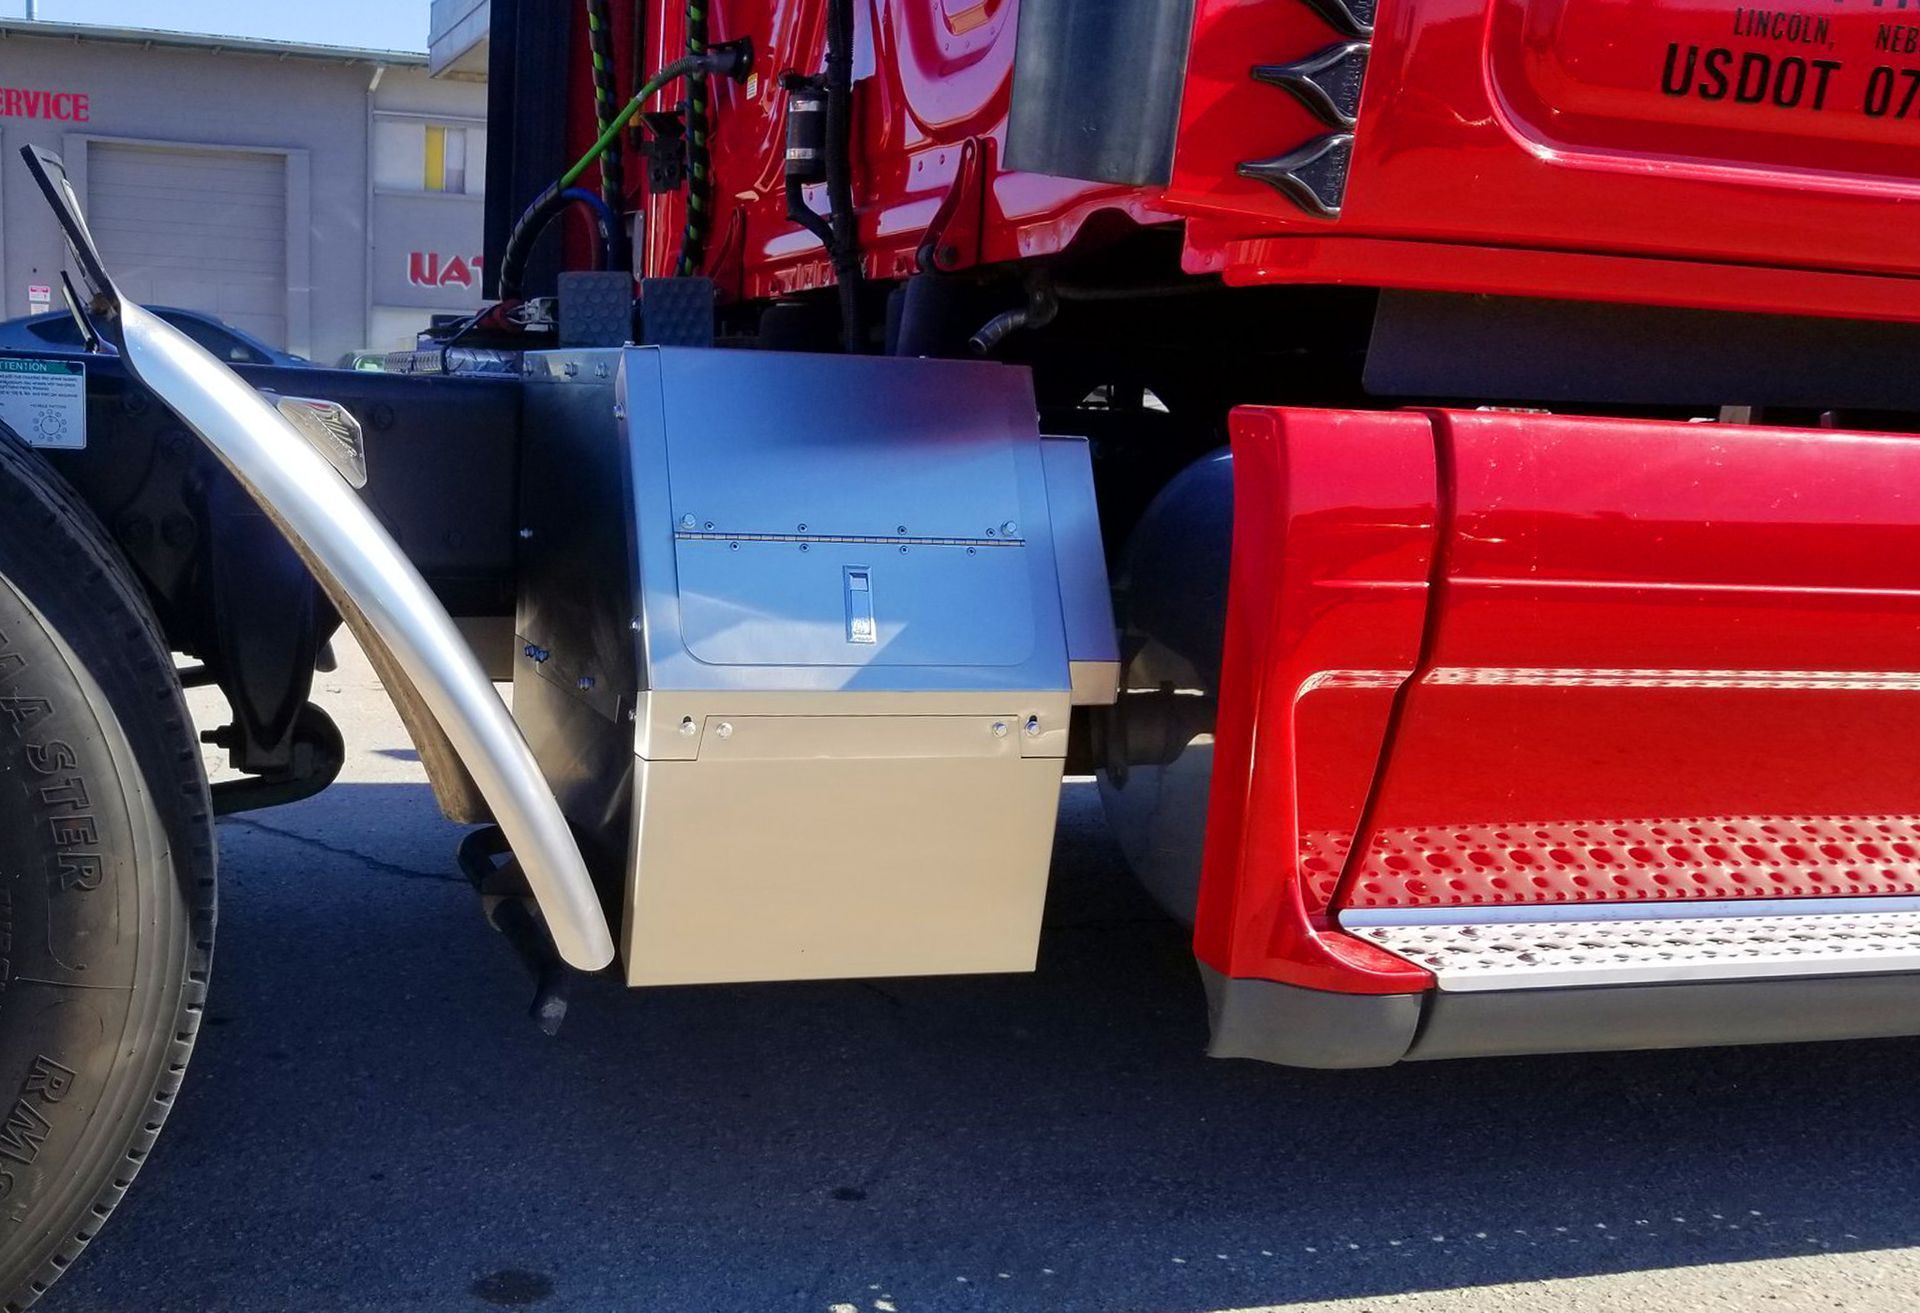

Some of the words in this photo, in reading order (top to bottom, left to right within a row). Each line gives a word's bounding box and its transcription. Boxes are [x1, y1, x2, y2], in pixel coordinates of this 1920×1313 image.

[1733, 7, 1834, 49] LINCOLN,
[1875, 23, 1920, 54] NEB
[0, 87, 89, 122] RVICE
[1661, 42, 1842, 111] USDOT
[1863, 65, 1920, 120] 07
